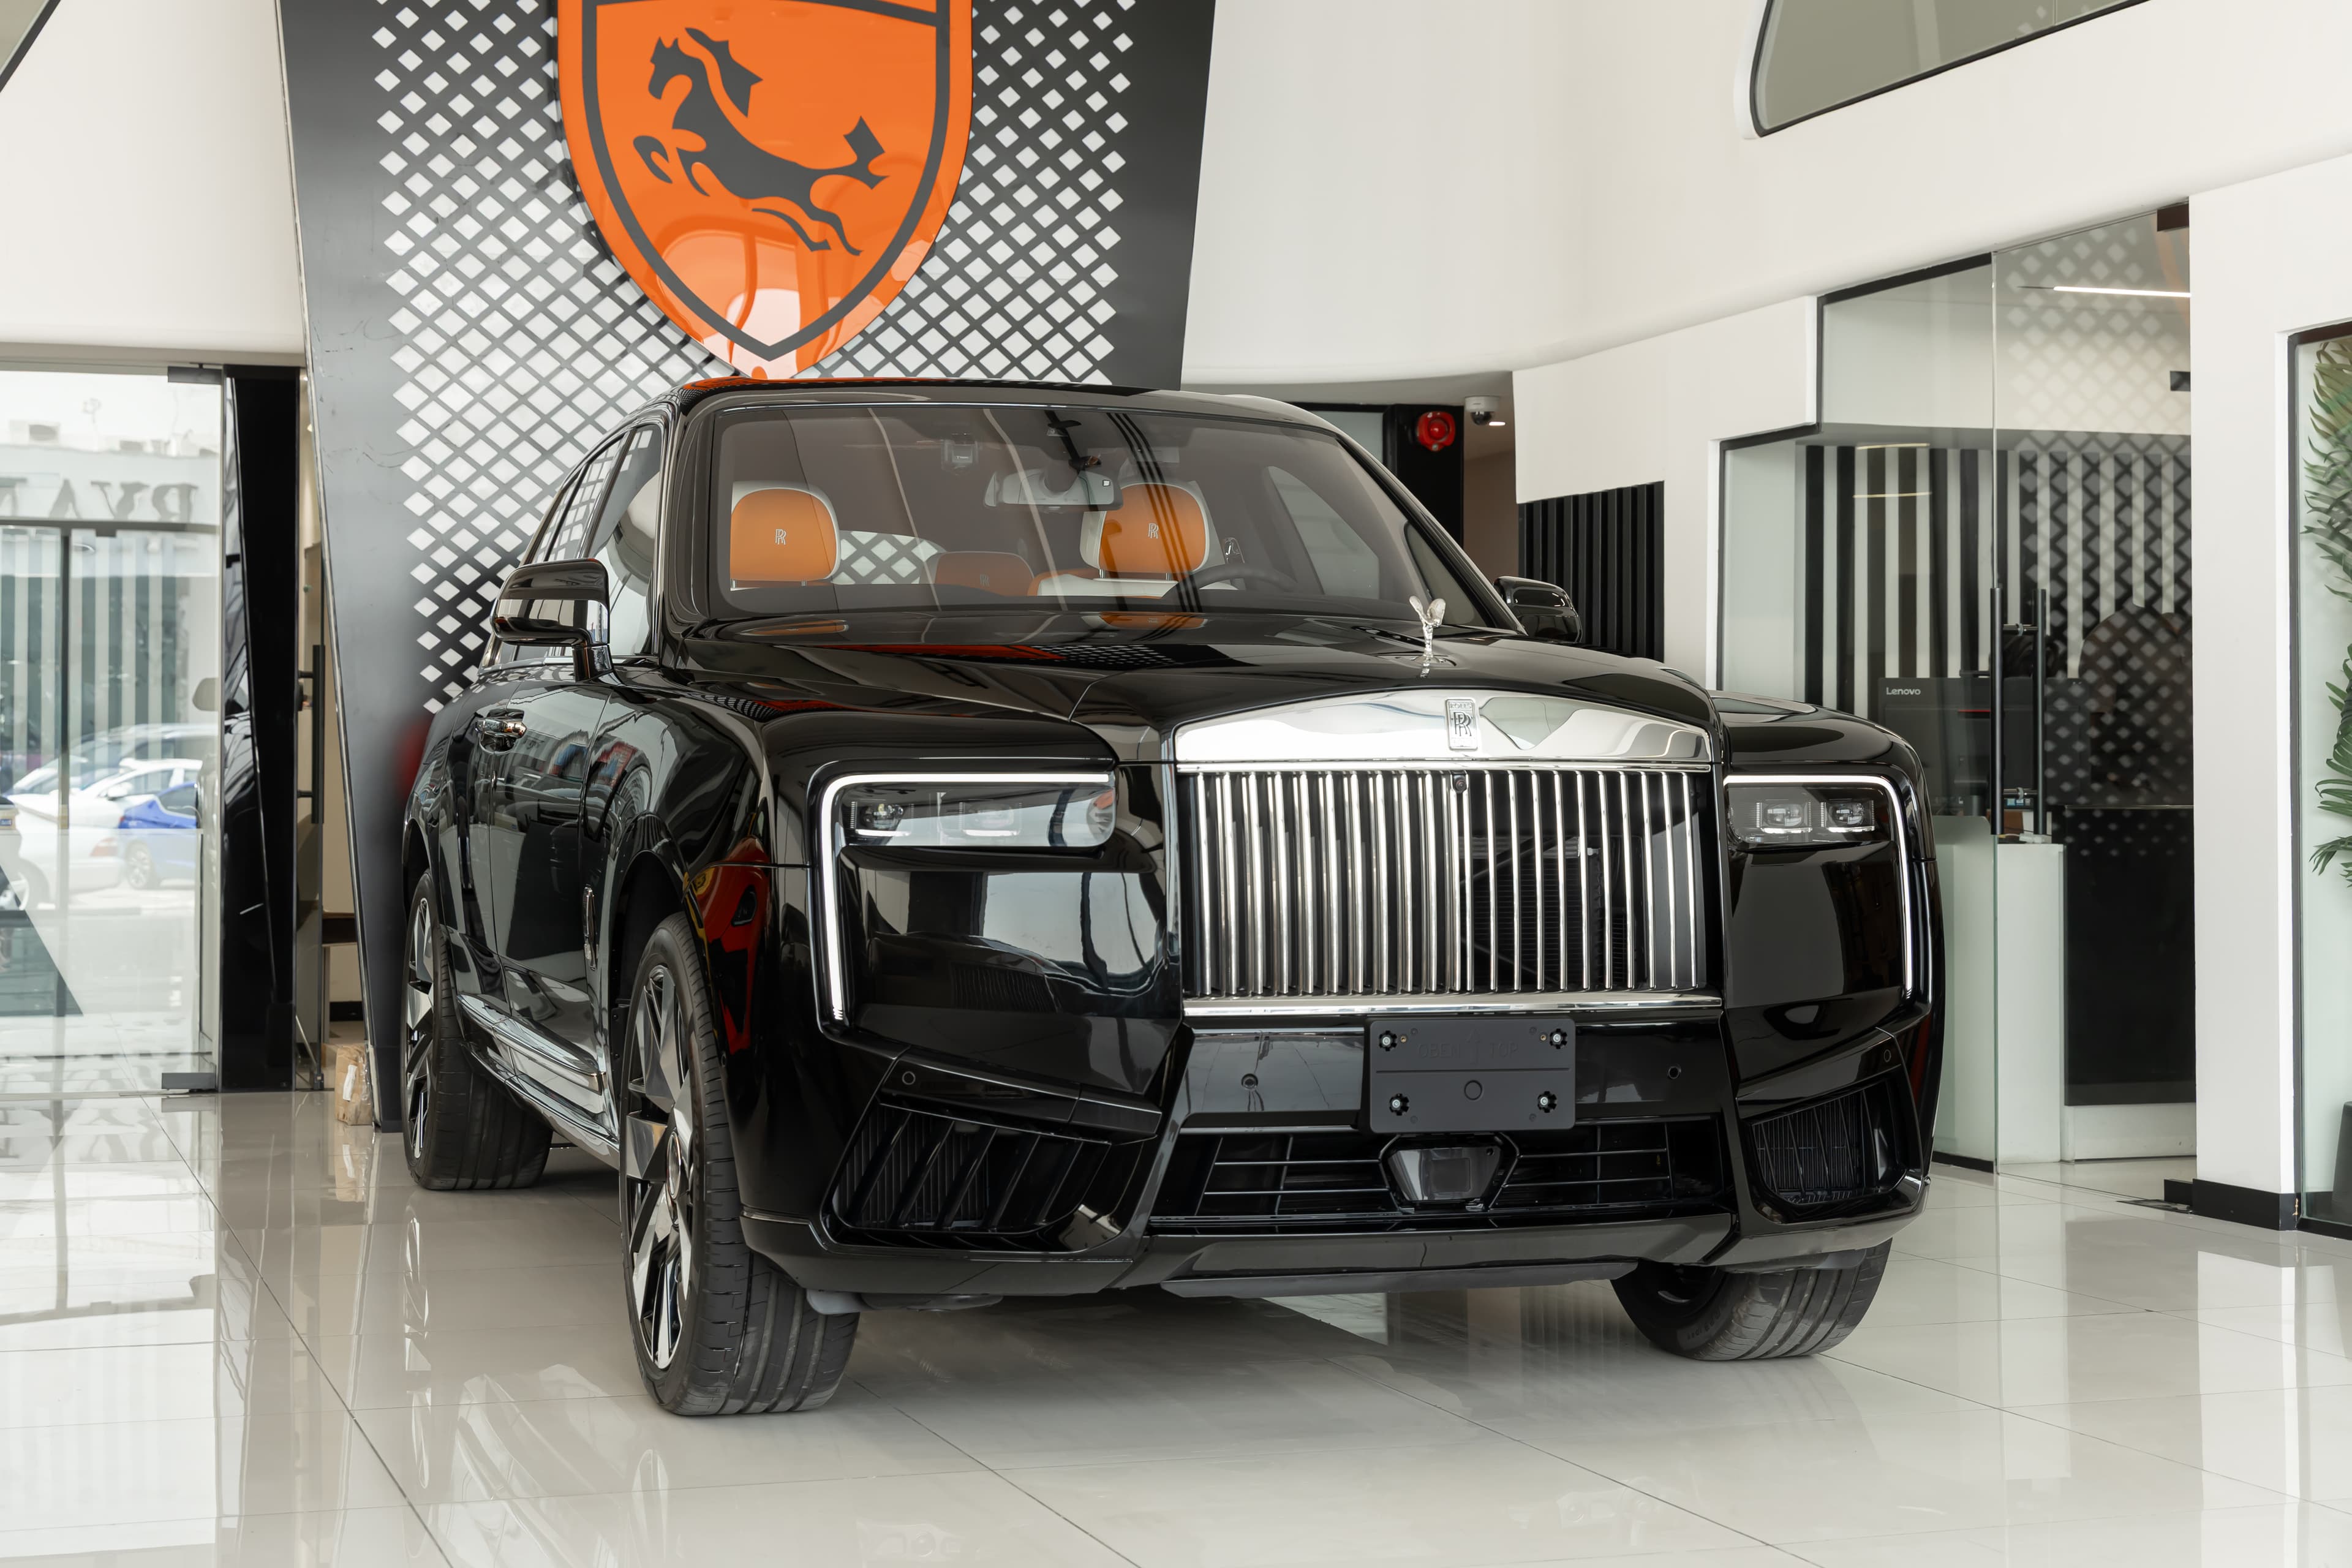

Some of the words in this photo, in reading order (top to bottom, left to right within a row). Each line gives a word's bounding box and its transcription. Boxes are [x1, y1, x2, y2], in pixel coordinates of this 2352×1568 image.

[1886, 687, 1921, 695] Lenovo
[1417, 1043, 1461, 1059] OBEN
[1489, 1042, 1519, 1059] TOP
